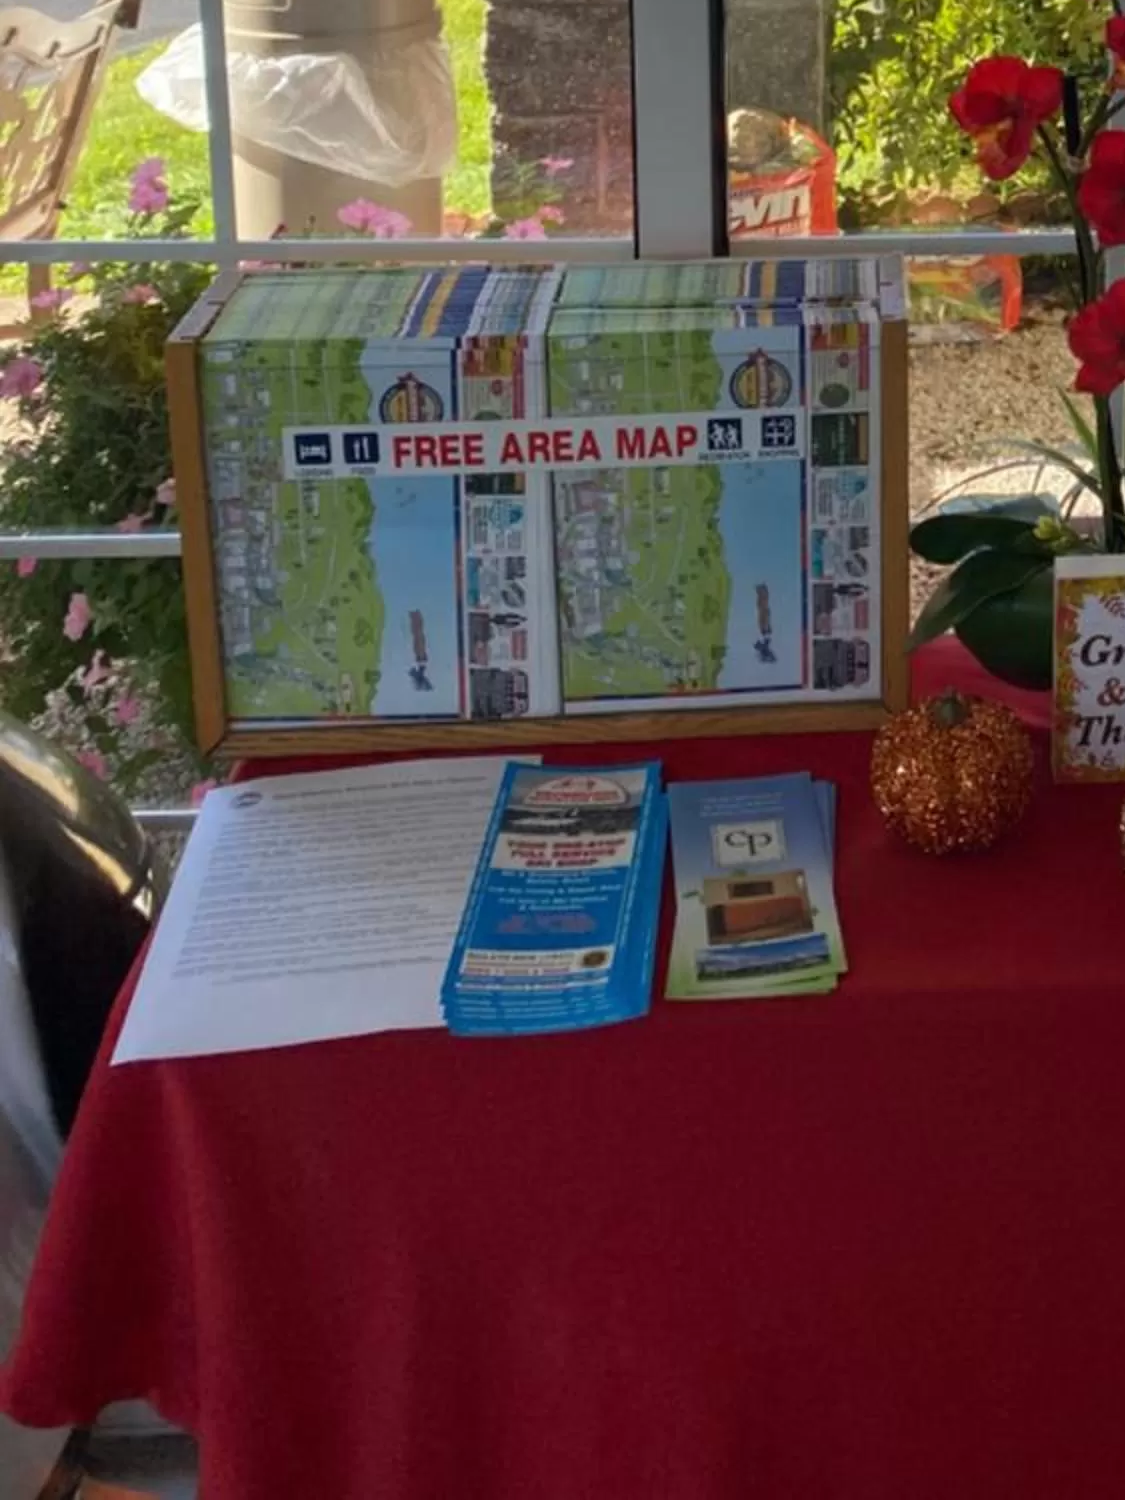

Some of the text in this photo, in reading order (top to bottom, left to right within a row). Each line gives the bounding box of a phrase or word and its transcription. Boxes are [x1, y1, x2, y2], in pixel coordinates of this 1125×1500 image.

[393, 425, 698, 469] FREE AREA MAP
